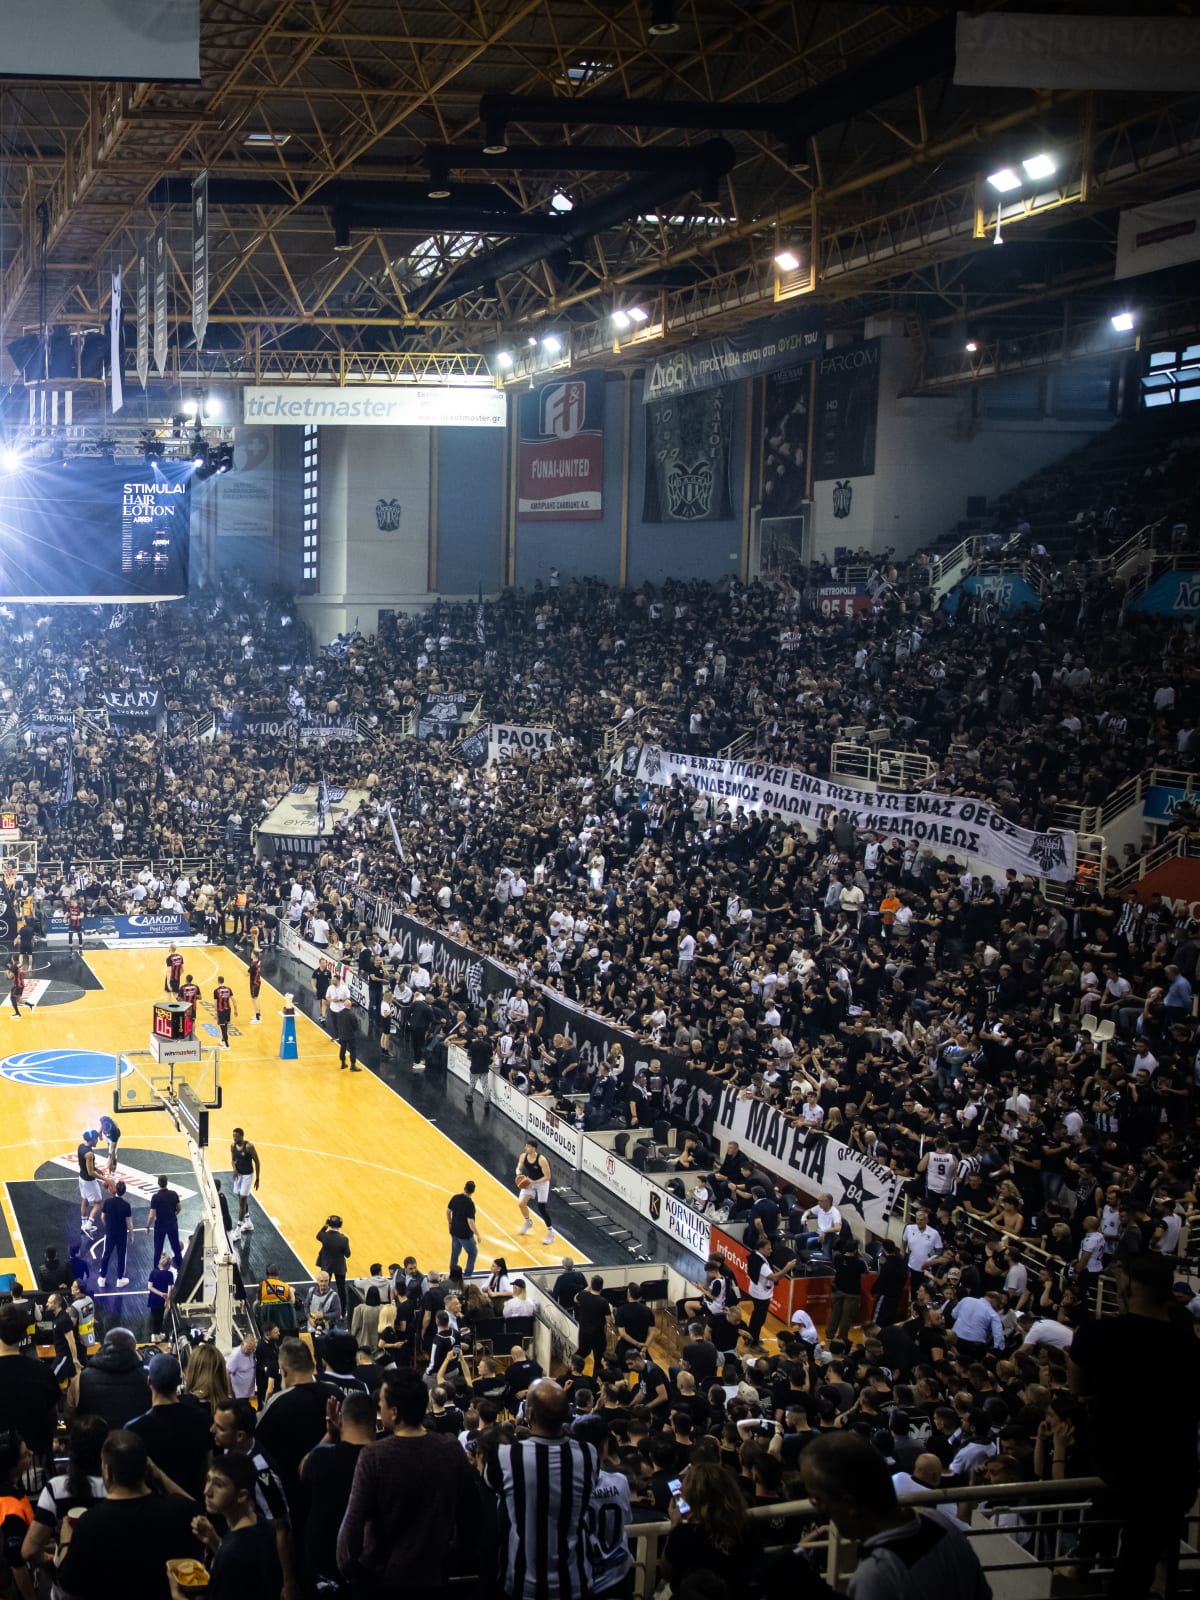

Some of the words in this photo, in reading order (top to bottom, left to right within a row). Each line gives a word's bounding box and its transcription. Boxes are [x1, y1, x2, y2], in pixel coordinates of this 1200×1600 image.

[820, 347, 878, 376] FARCOM
[247, 395, 400, 418] ticketmaster
[531, 456, 590, 481] FUNAI-UNITED
[123, 494, 155, 505] HAIR
[123, 505, 175, 516] LOTION
[729, 762, 787, 787] ΥΠΑΡΧΕΙ
[790, 774, 822, 794] ΕΝΑ
[826, 783, 899, 810] ΠΙΣΤΕΥΩ
[904, 796, 956, 817] ΕΝΑΣ
[762, 790, 812, 817] ΦΙΛΩΝ
[815, 803, 863, 829] ΠΟΚ
[864, 813, 981, 852] ΝΕΑΠΟΛΕΩΣ
[528, 1112, 577, 1156] SIDIROPOULOS
[665, 1195, 712, 1240] KORNILIOS
[668, 1214, 706, 1254] PALACE
